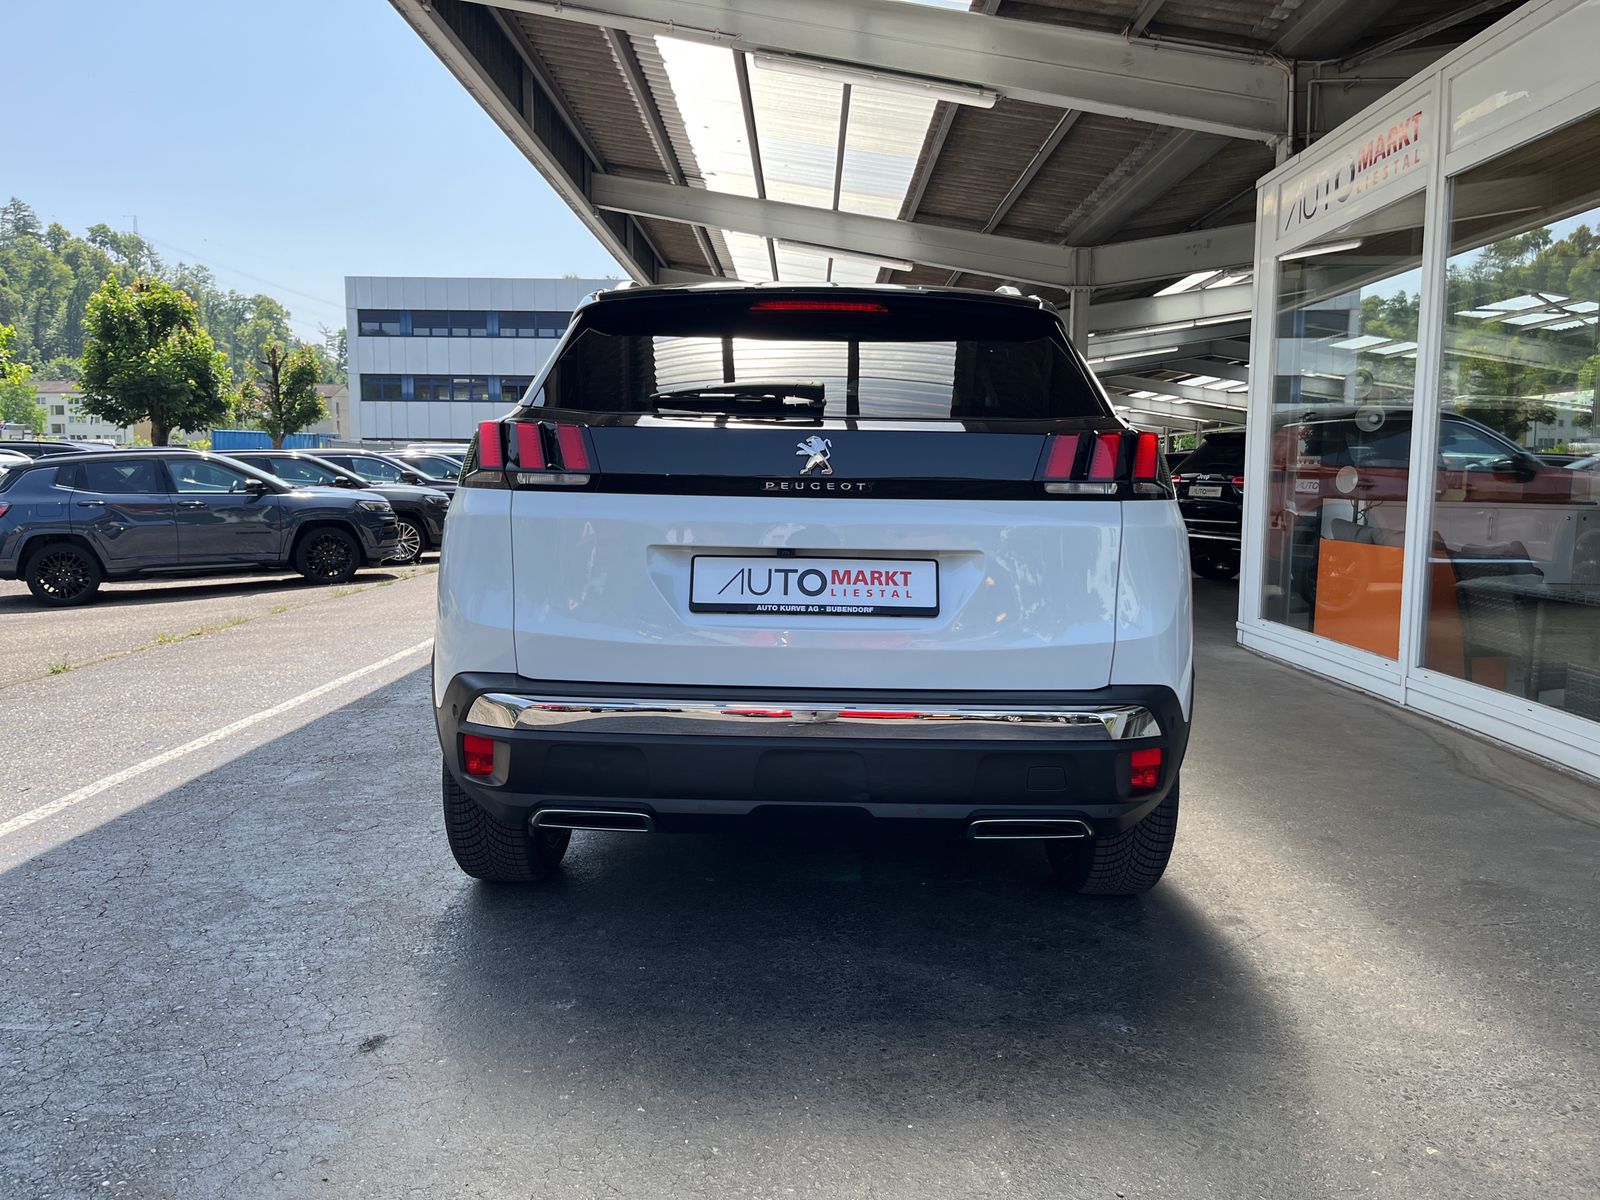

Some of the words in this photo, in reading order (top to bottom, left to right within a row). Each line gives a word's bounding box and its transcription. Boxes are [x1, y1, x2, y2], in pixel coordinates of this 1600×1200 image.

[1357, 111, 1423, 173] MARKT
[1355, 149, 1421, 194] LIESTAL
[765, 482, 866, 490] PEUGEOT
[717, 568, 827, 597] AUTO
[831, 569, 912, 587] MARKT
[831, 588, 912, 598] LIESTAL
